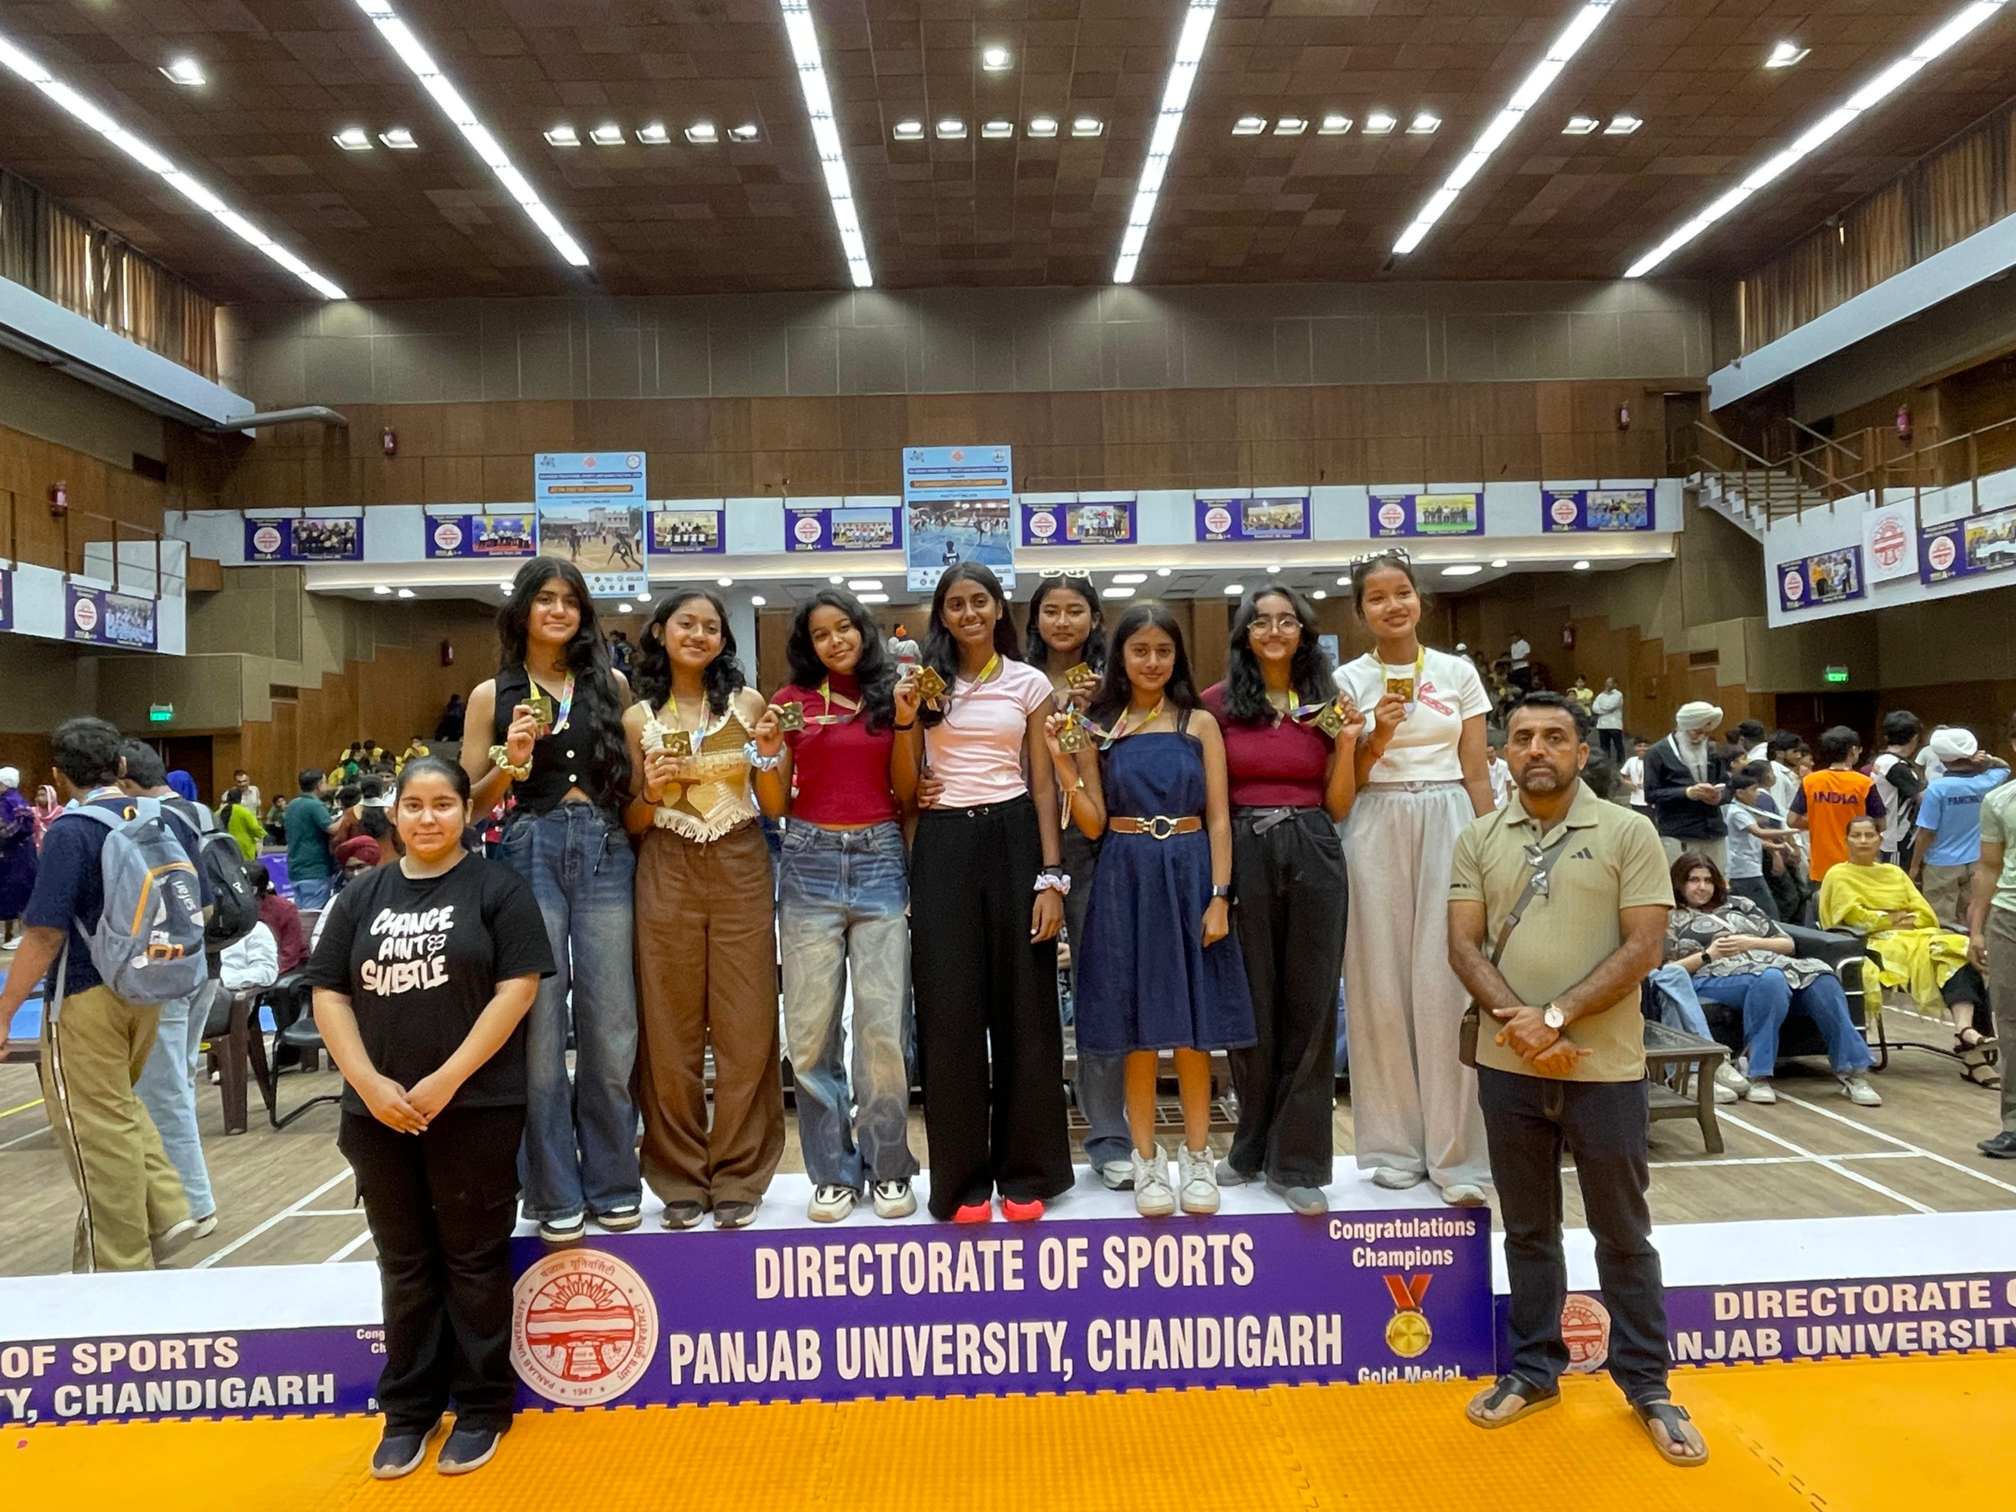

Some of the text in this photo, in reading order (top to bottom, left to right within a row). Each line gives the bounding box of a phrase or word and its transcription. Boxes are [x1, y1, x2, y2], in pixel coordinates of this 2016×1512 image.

[1814, 791, 1858, 805] INDIA
[378, 933, 431, 961] AINT
[361, 955, 450, 997] SUBTLE
[1329, 1217, 1477, 1244] Congratulations
[755, 1232, 1256, 1300] DIRECTORATE OF SPORTS
[1352, 1246, 1454, 1271] Champions
[1714, 1280, 1992, 1321] DIRECTORATE
[0, 1336, 240, 1379] OF SPORTS
[669, 1313, 1343, 1386] PANJAB UNIVERSITY, CHANDIGARH
[1668, 1317, 2016, 1362] NJAB UNIVERSIT
[1357, 1365, 1461, 1384] Gold Medal
[54, 1373, 335, 1418] CHANDIGARH
